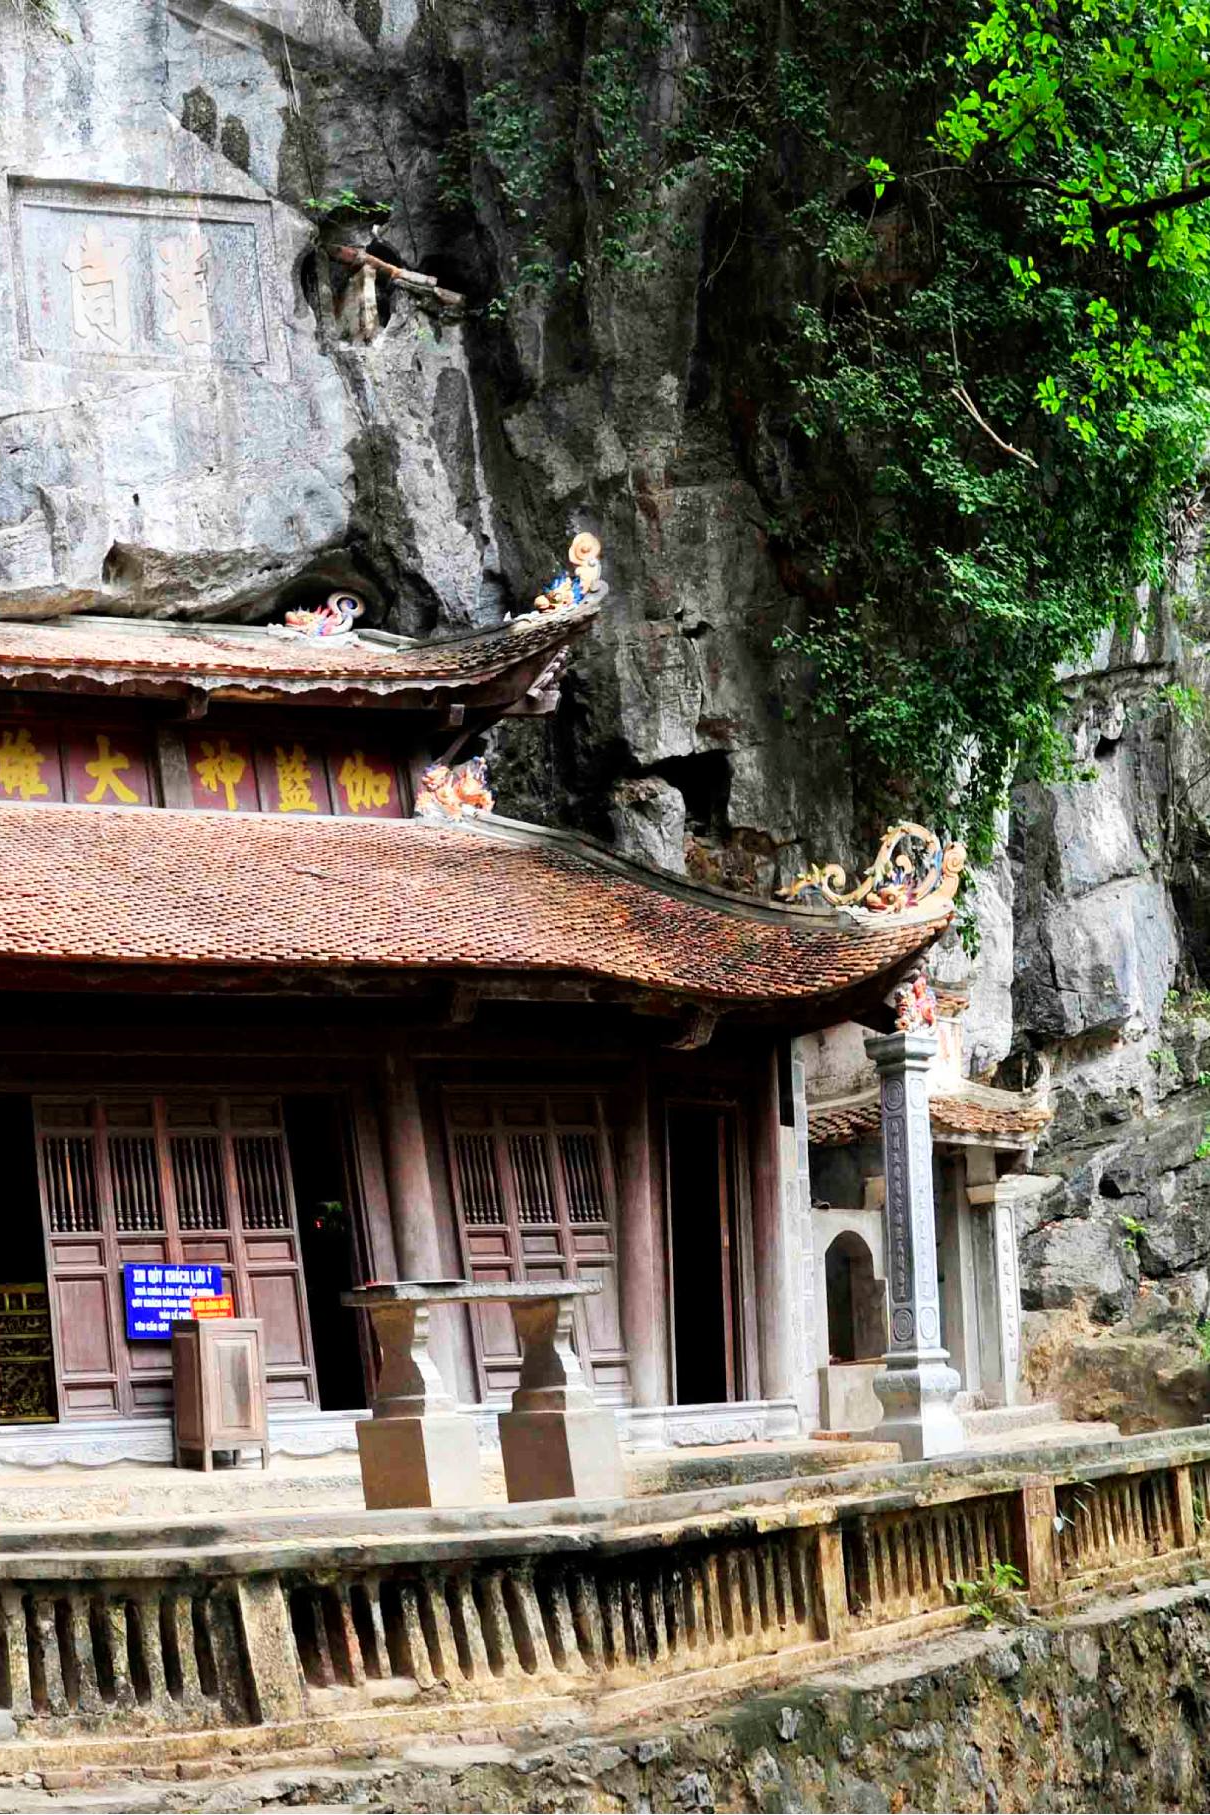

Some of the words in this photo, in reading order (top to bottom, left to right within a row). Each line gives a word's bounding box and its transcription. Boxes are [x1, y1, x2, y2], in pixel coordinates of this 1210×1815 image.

[133, 1269, 146, 1283] XIN
[148, 1266, 163, 1284] QUÝ
[164, 1266, 190, 1283] KHÁCH
